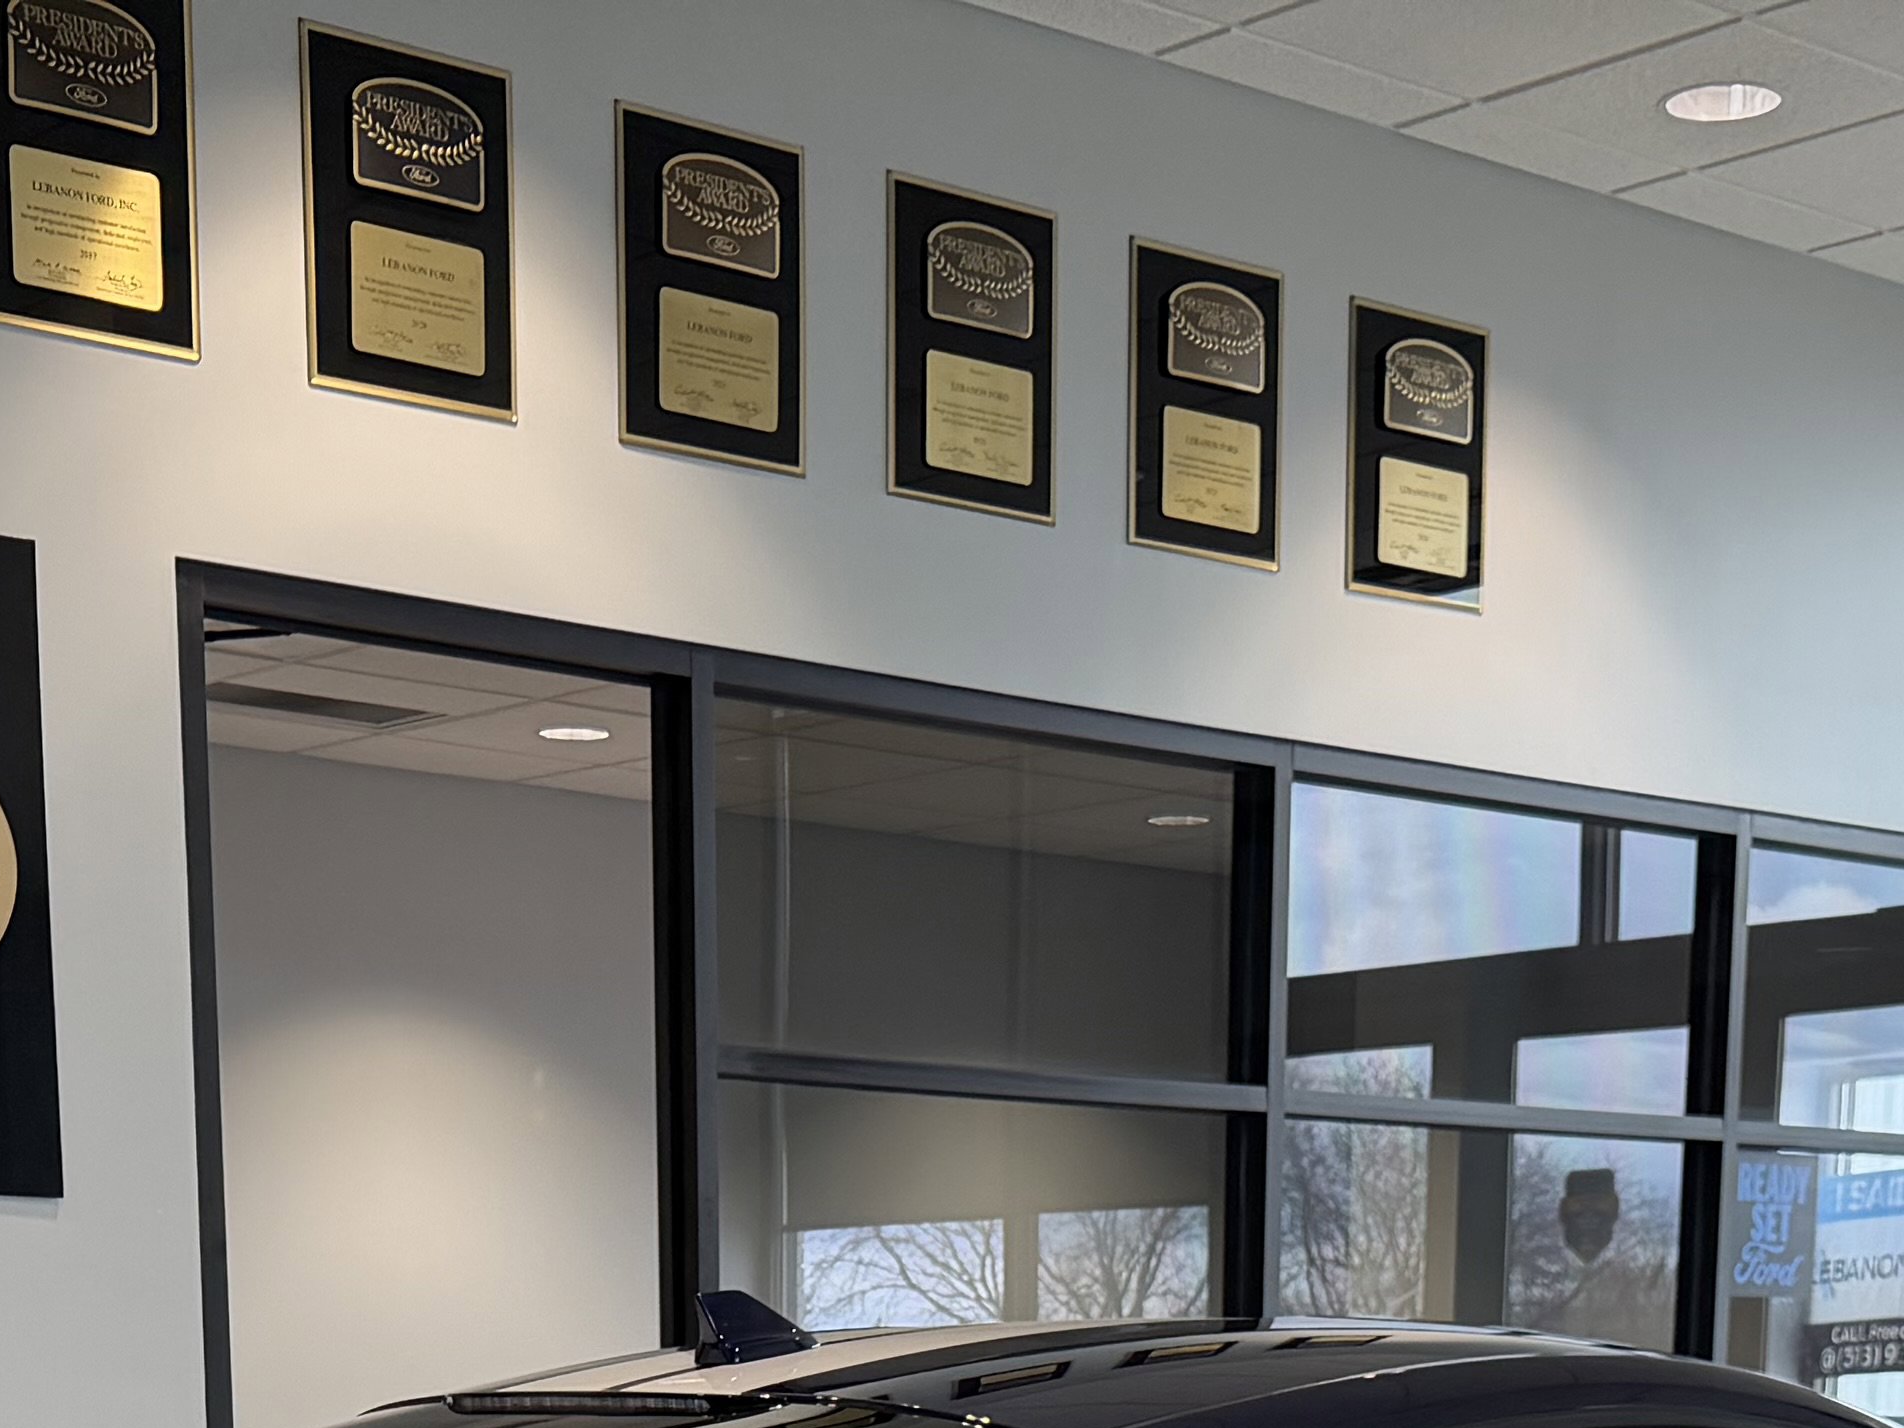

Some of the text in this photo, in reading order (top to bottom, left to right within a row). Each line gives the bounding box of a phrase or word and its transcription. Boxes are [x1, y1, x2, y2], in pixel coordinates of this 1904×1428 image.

[52, 22, 118, 58] AWARD
[390, 108, 449, 142] AWARD
[1736, 1163, 1812, 1204] READY
[1751, 1203, 1791, 1241] SET
